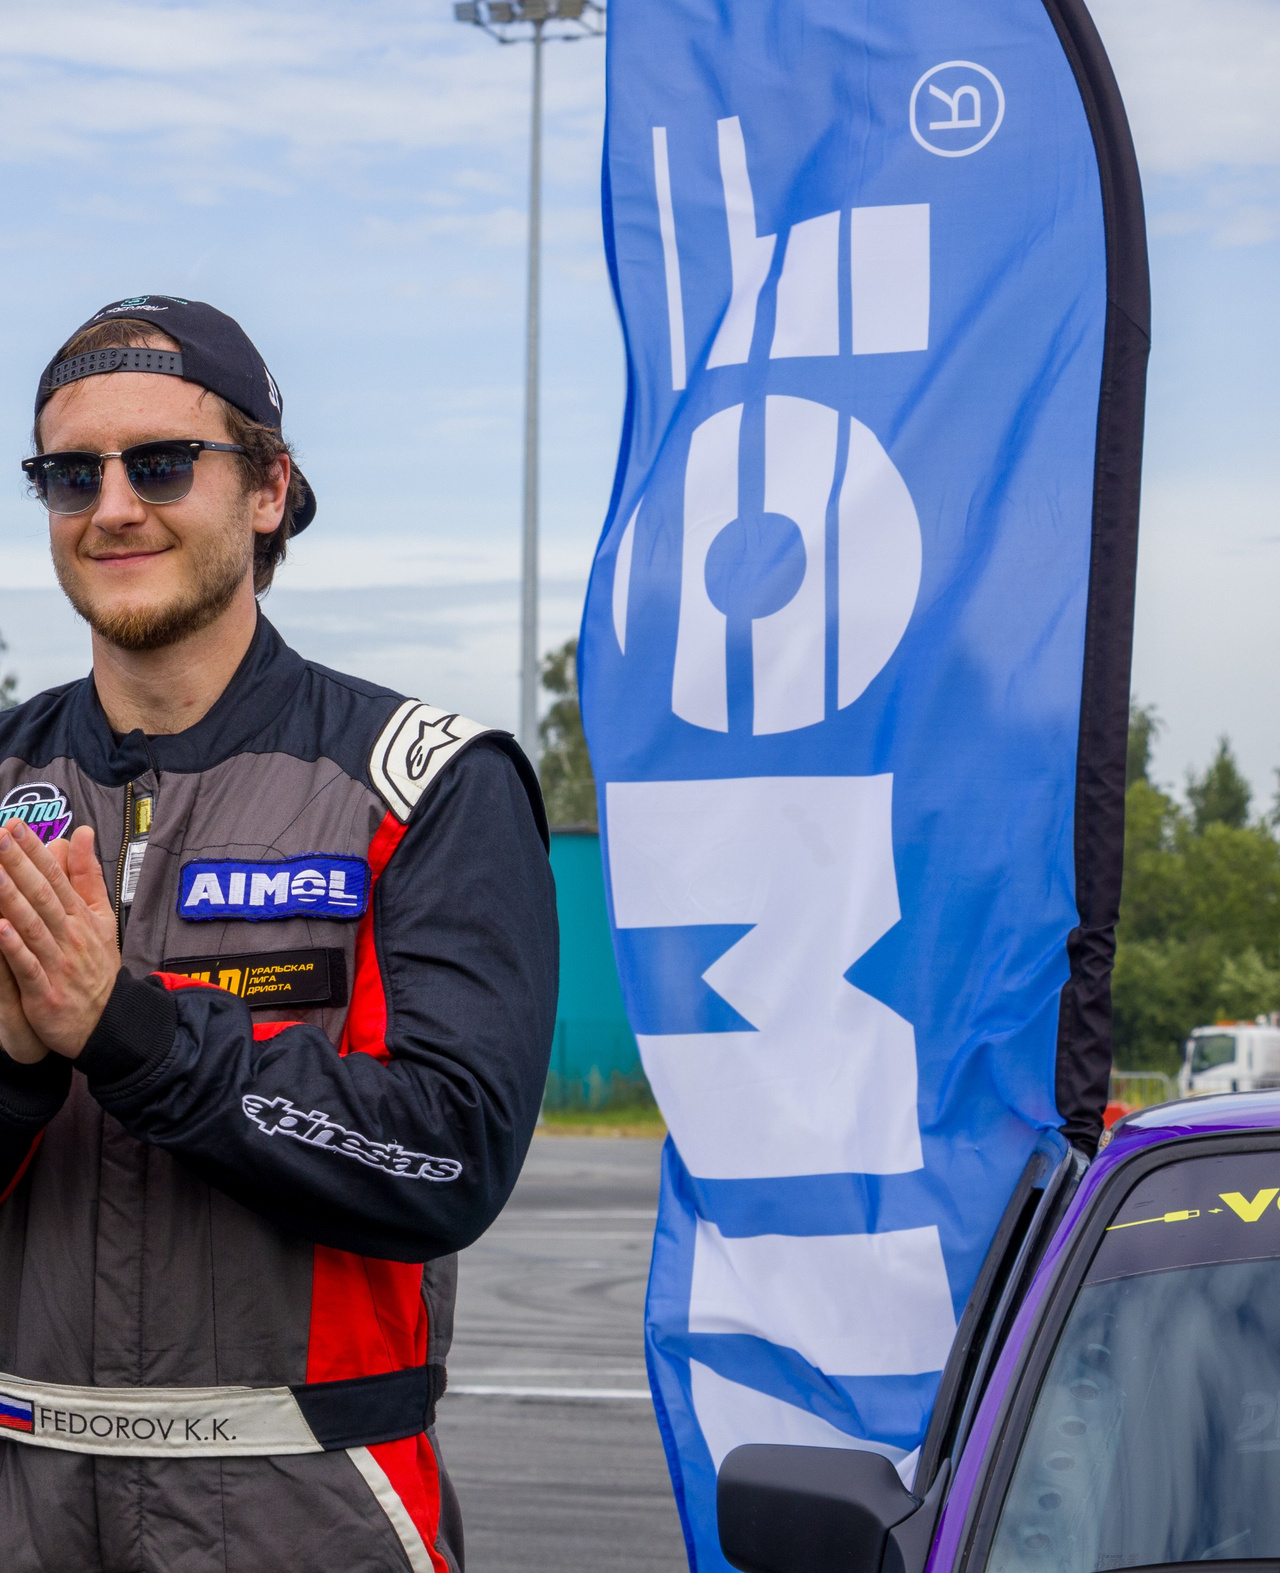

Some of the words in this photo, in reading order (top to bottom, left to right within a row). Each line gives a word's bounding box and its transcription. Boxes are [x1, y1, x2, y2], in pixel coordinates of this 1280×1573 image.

[28, 801, 61, 823] ПО
[184, 869, 358, 907] AIMOL
[249, 975, 277, 985] ЛИГА
[251, 963, 314, 976] УРАЛЬСКАЯ
[246, 983, 292, 996] ДРИФТА
[1218, 1187, 1280, 1223] V
[40, 1407, 174, 1441] FEDOROV
[185, 1418, 237, 1441] K.K.
